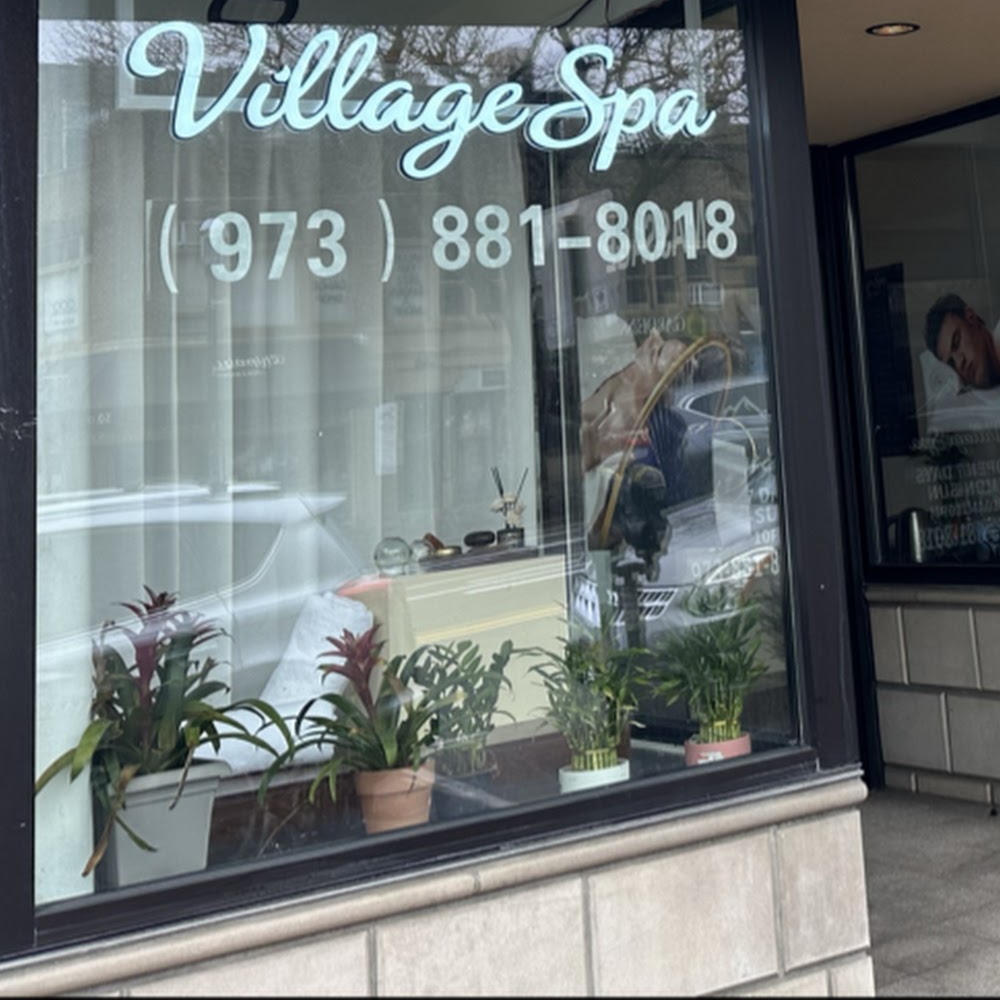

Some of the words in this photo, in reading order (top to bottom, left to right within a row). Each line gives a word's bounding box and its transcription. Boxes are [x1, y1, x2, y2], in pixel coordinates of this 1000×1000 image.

[124, 20, 530, 181] Village
[524, 44, 717, 171] Spa
[431, 199, 739, 272] 881-8018
